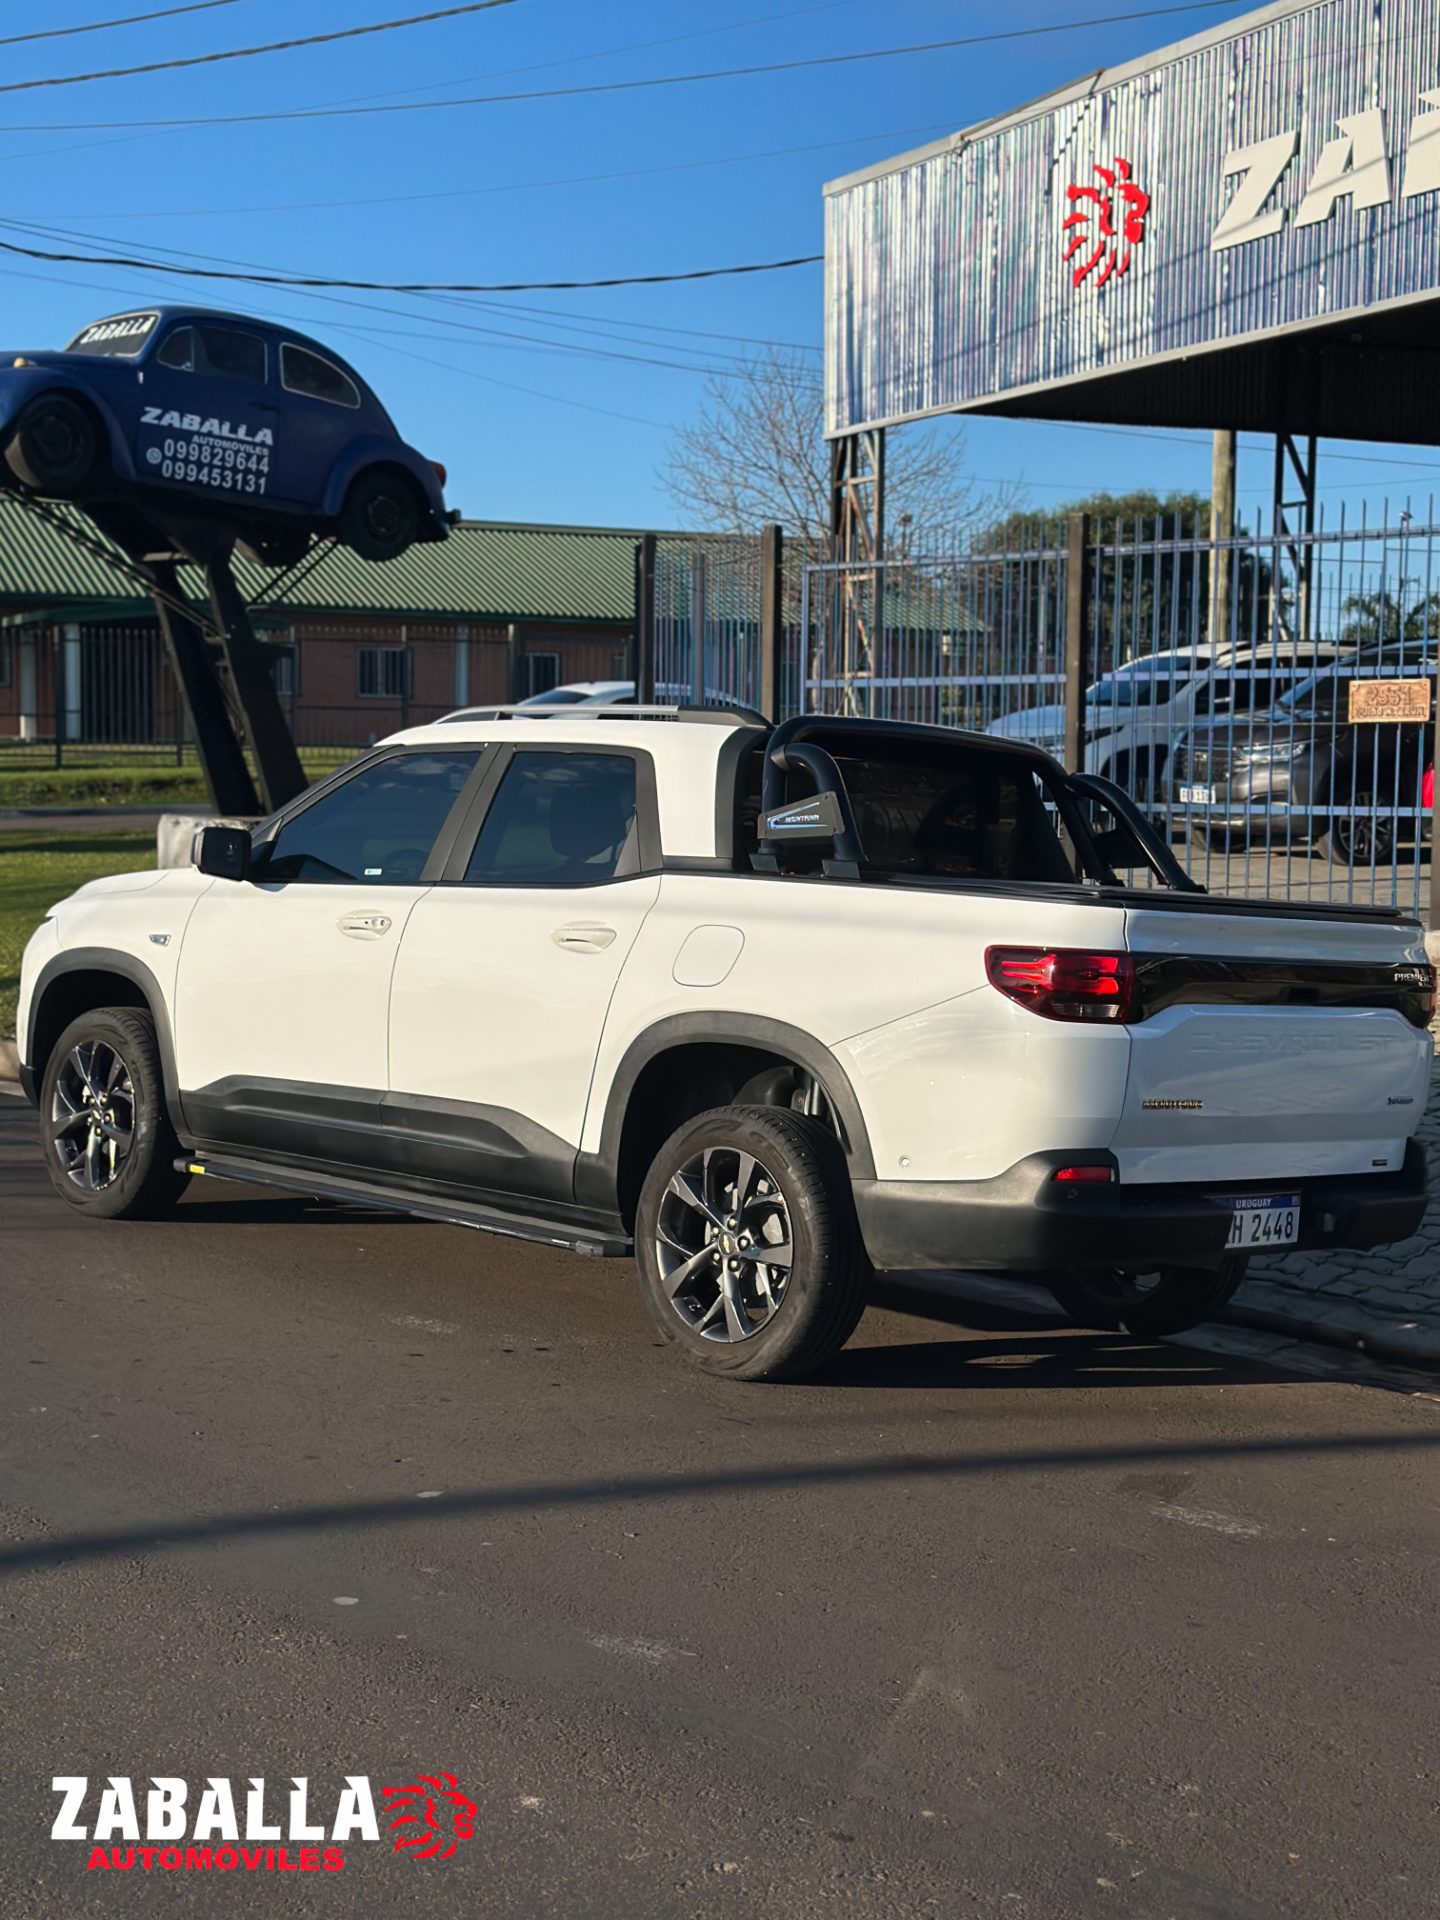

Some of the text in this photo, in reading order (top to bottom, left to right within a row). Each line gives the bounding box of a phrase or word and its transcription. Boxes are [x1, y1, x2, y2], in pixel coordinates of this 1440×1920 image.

[80, 316, 156, 344] ZABALLA
[140, 406, 273, 446] ZABALLA
[164, 438, 269, 474] 099829644
[161, 459, 266, 495] 099453131
[1235, 1198, 1272, 1209] URUGUAY
[1226, 1211, 1294, 1244] H 2448
